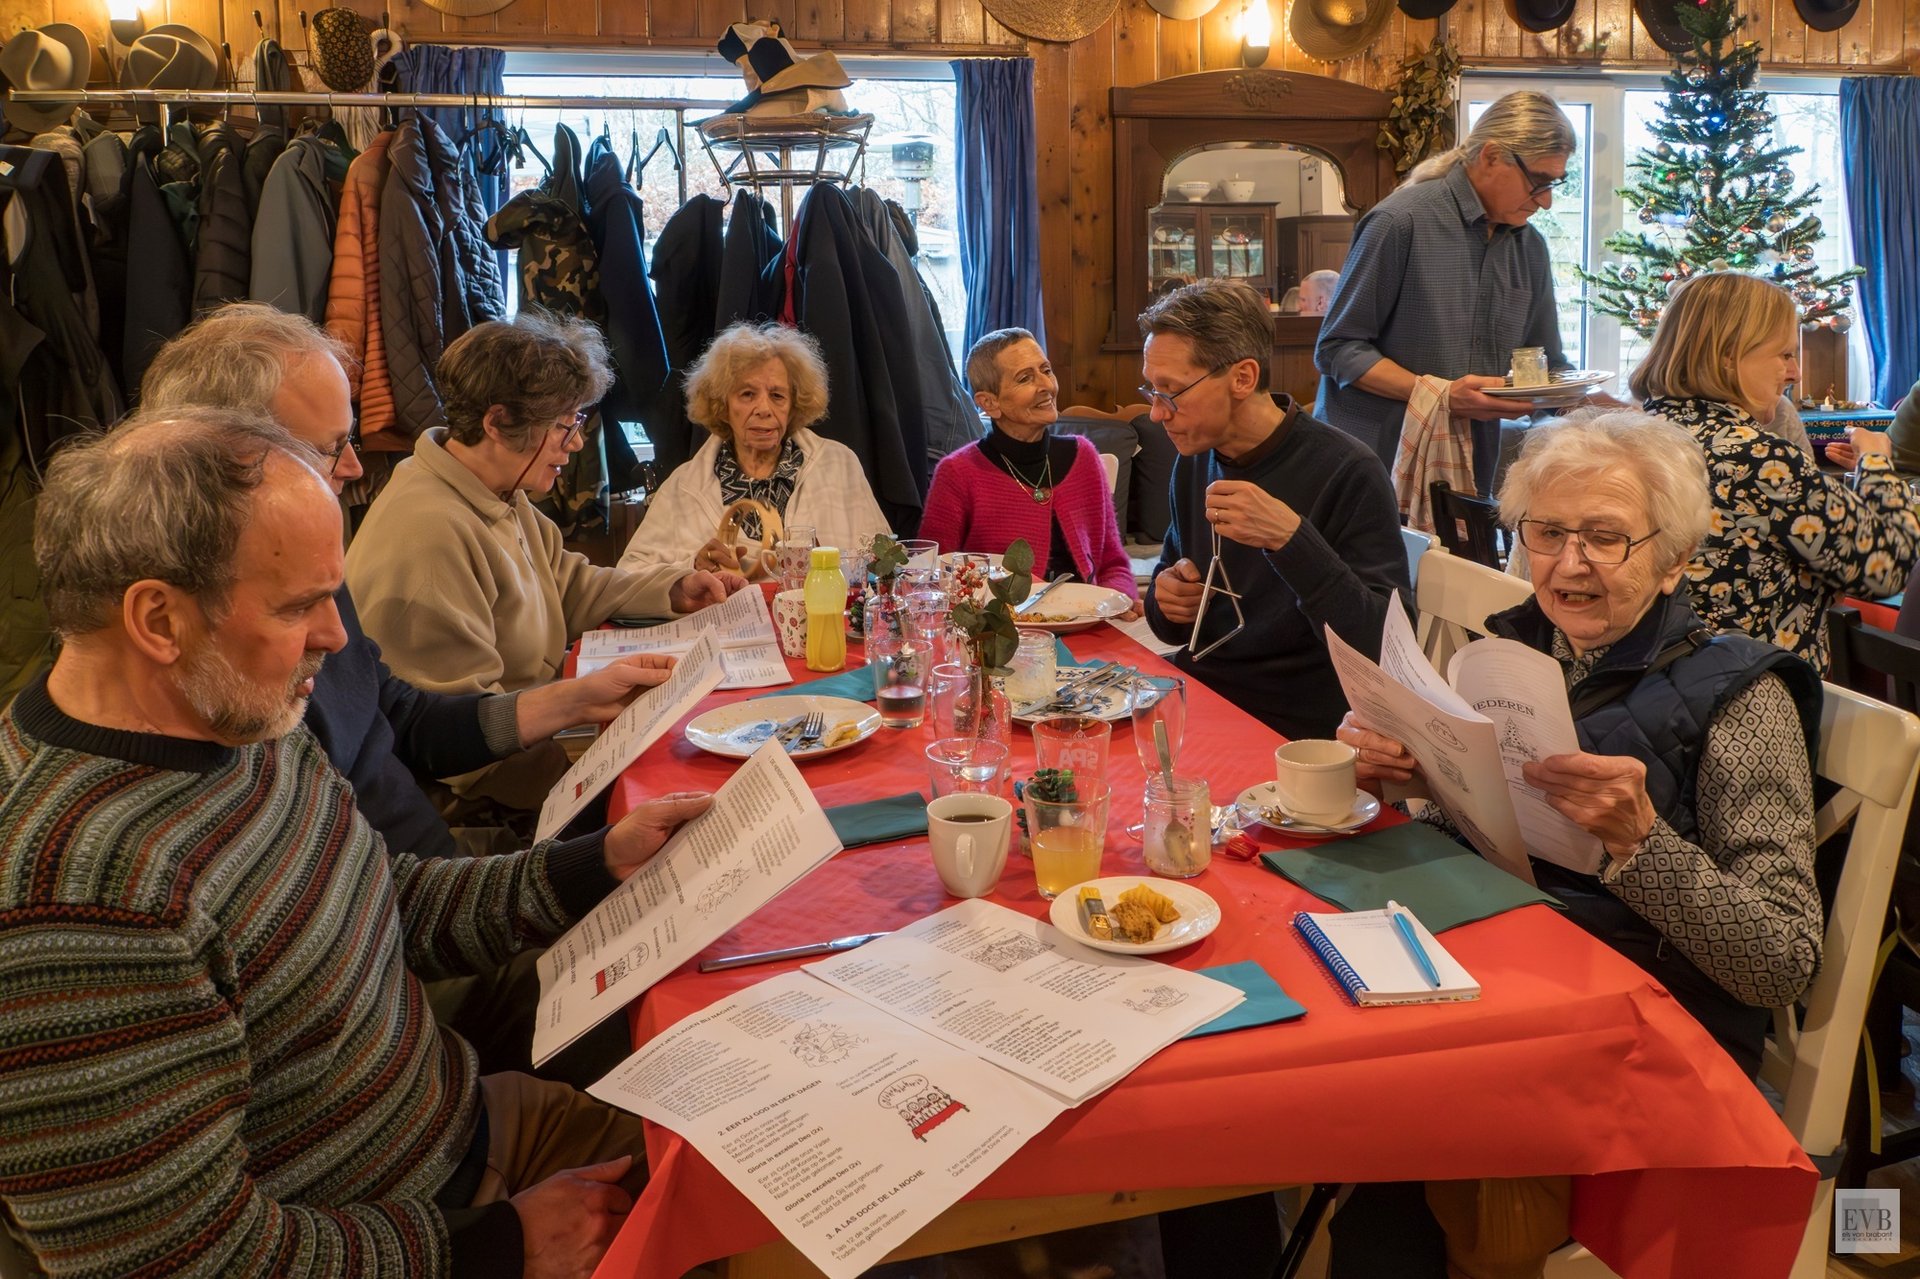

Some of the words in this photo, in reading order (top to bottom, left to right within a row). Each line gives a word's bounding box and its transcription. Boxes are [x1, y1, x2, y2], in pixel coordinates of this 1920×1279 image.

[1472, 699, 1534, 717] IEDEREN
[726, 1121, 741, 1132] EER
[753, 1107, 770, 1116] GOD
[778, 1093, 795, 1103] DEZE
[796, 1080, 821, 1094] DAGEN
[747, 1161, 767, 1174] Gloria
[798, 1134, 811, 1142] Deo
[810, 1127, 823, 1135] (2x)
[785, 1197, 805, 1211] Gloria
[836, 1168, 849, 1178] Deo
[848, 1160, 861, 1169] (2x)
[841, 1216, 857, 1228] LAS
[856, 1201, 878, 1217] DOCE
[877, 1194, 889, 1203] DE
[899, 1170, 924, 1188] NOCHE
